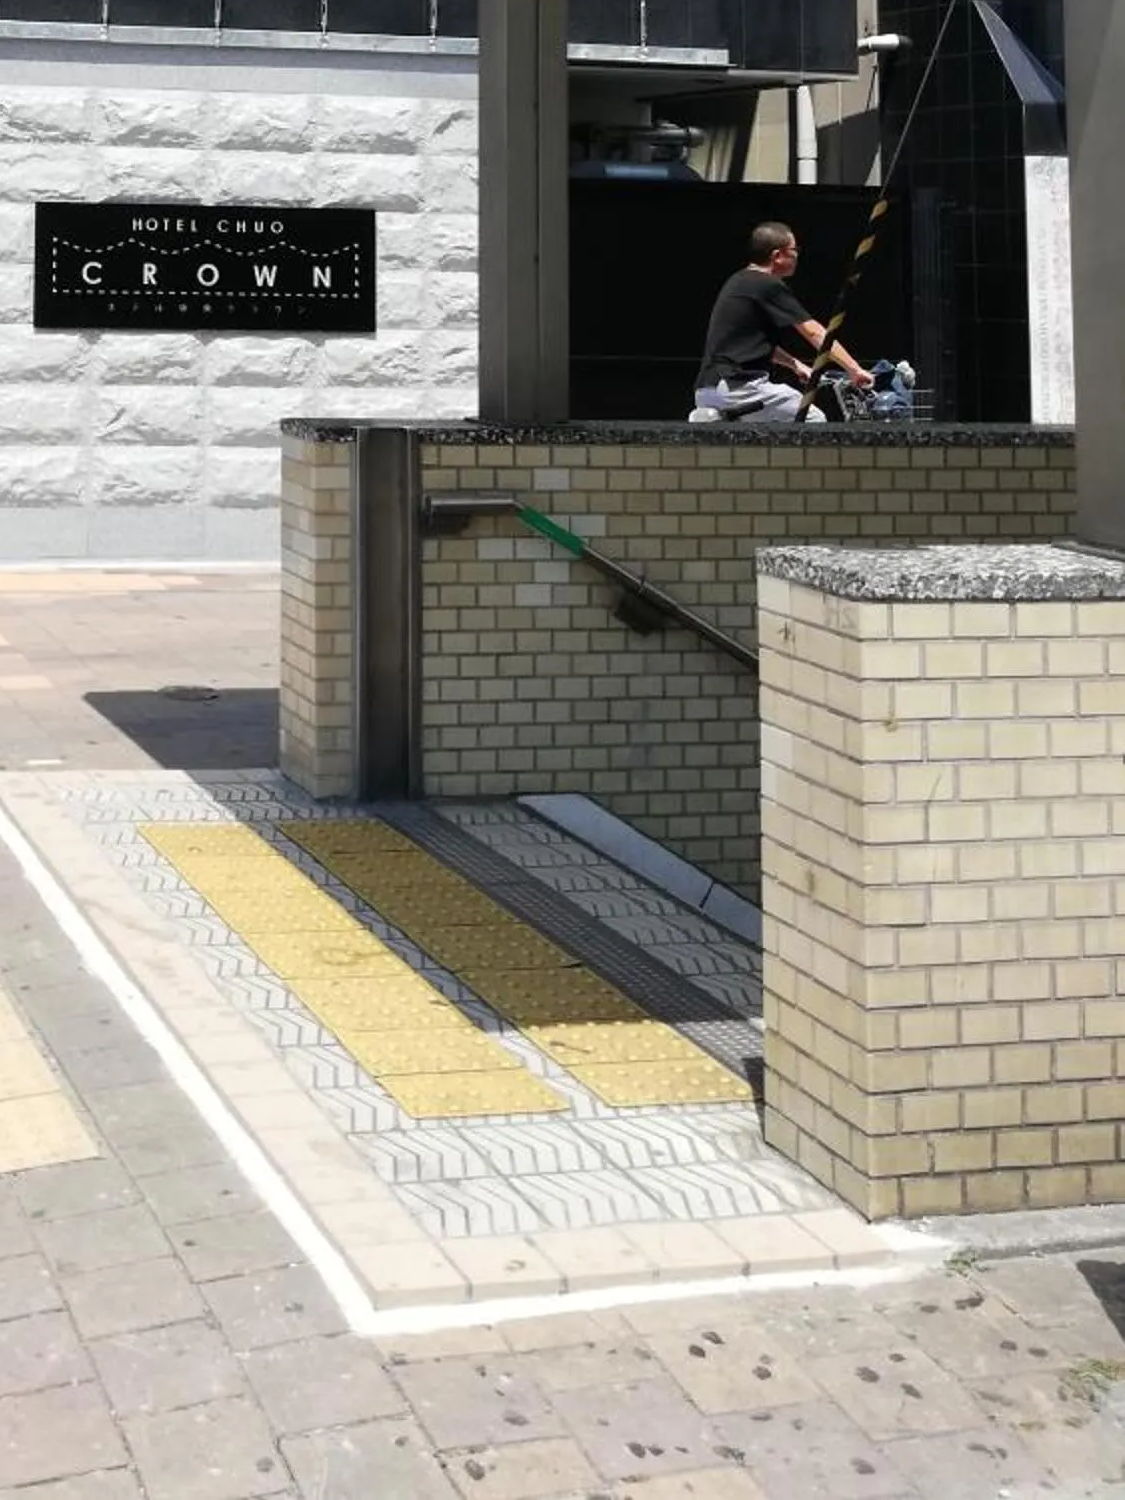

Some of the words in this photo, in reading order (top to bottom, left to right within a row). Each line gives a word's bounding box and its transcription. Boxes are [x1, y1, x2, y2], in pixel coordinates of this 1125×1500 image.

[132, 217, 198, 233] HOTEL
[217, 219, 284, 234] CHUO
[81, 261, 332, 289] CROWN
